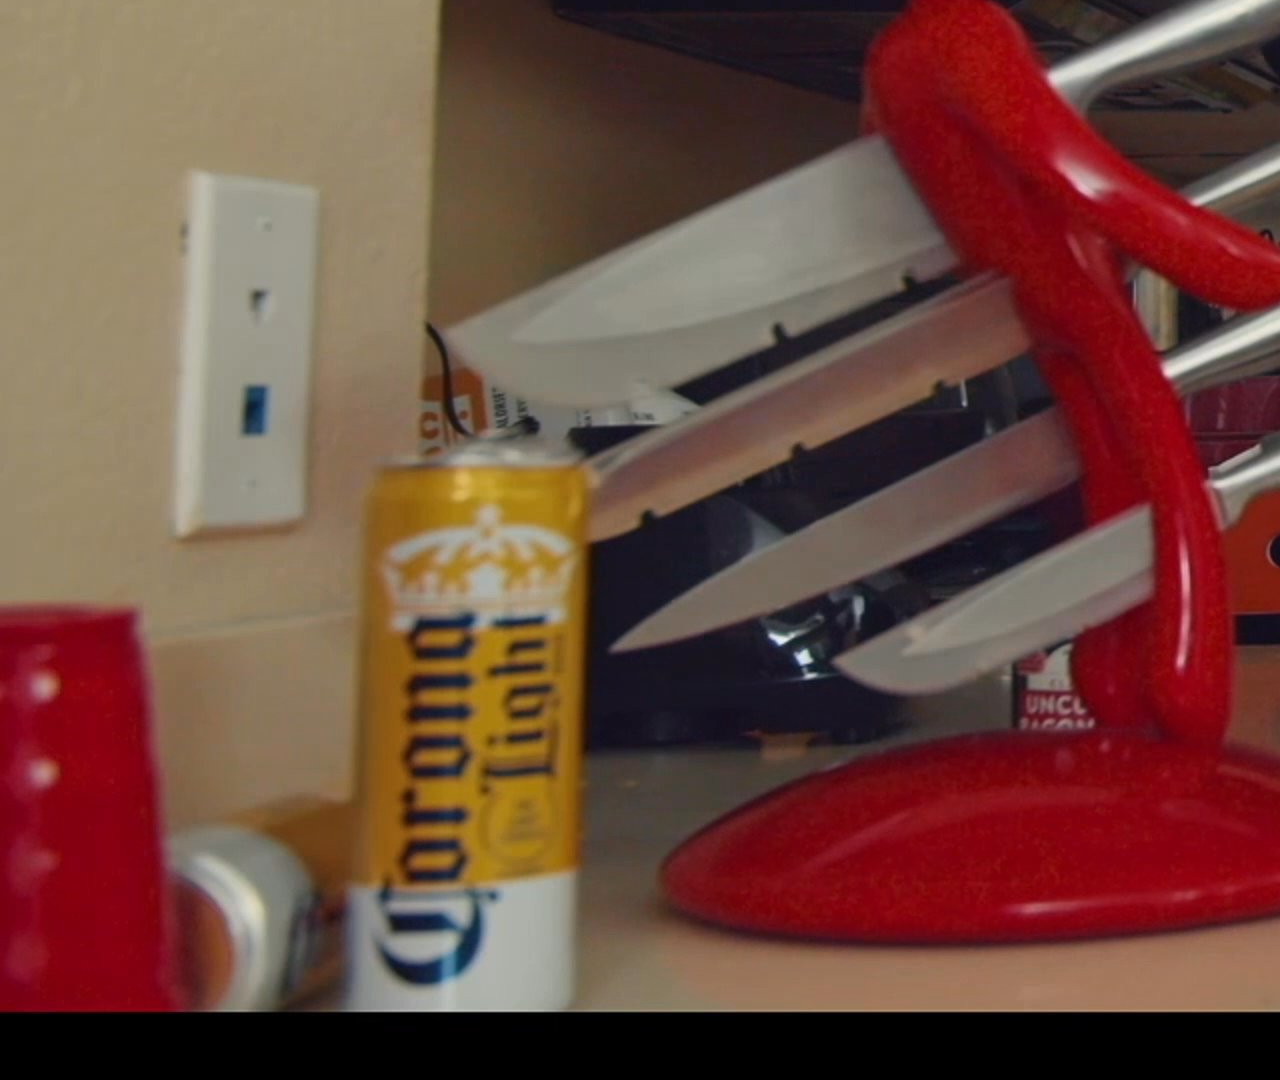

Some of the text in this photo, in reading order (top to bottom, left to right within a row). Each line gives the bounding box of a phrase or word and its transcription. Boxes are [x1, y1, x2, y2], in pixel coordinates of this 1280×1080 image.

[479, 615, 557, 794] Light
[1025, 694, 1088, 716] UNCL
[374, 610, 498, 986] Corona
